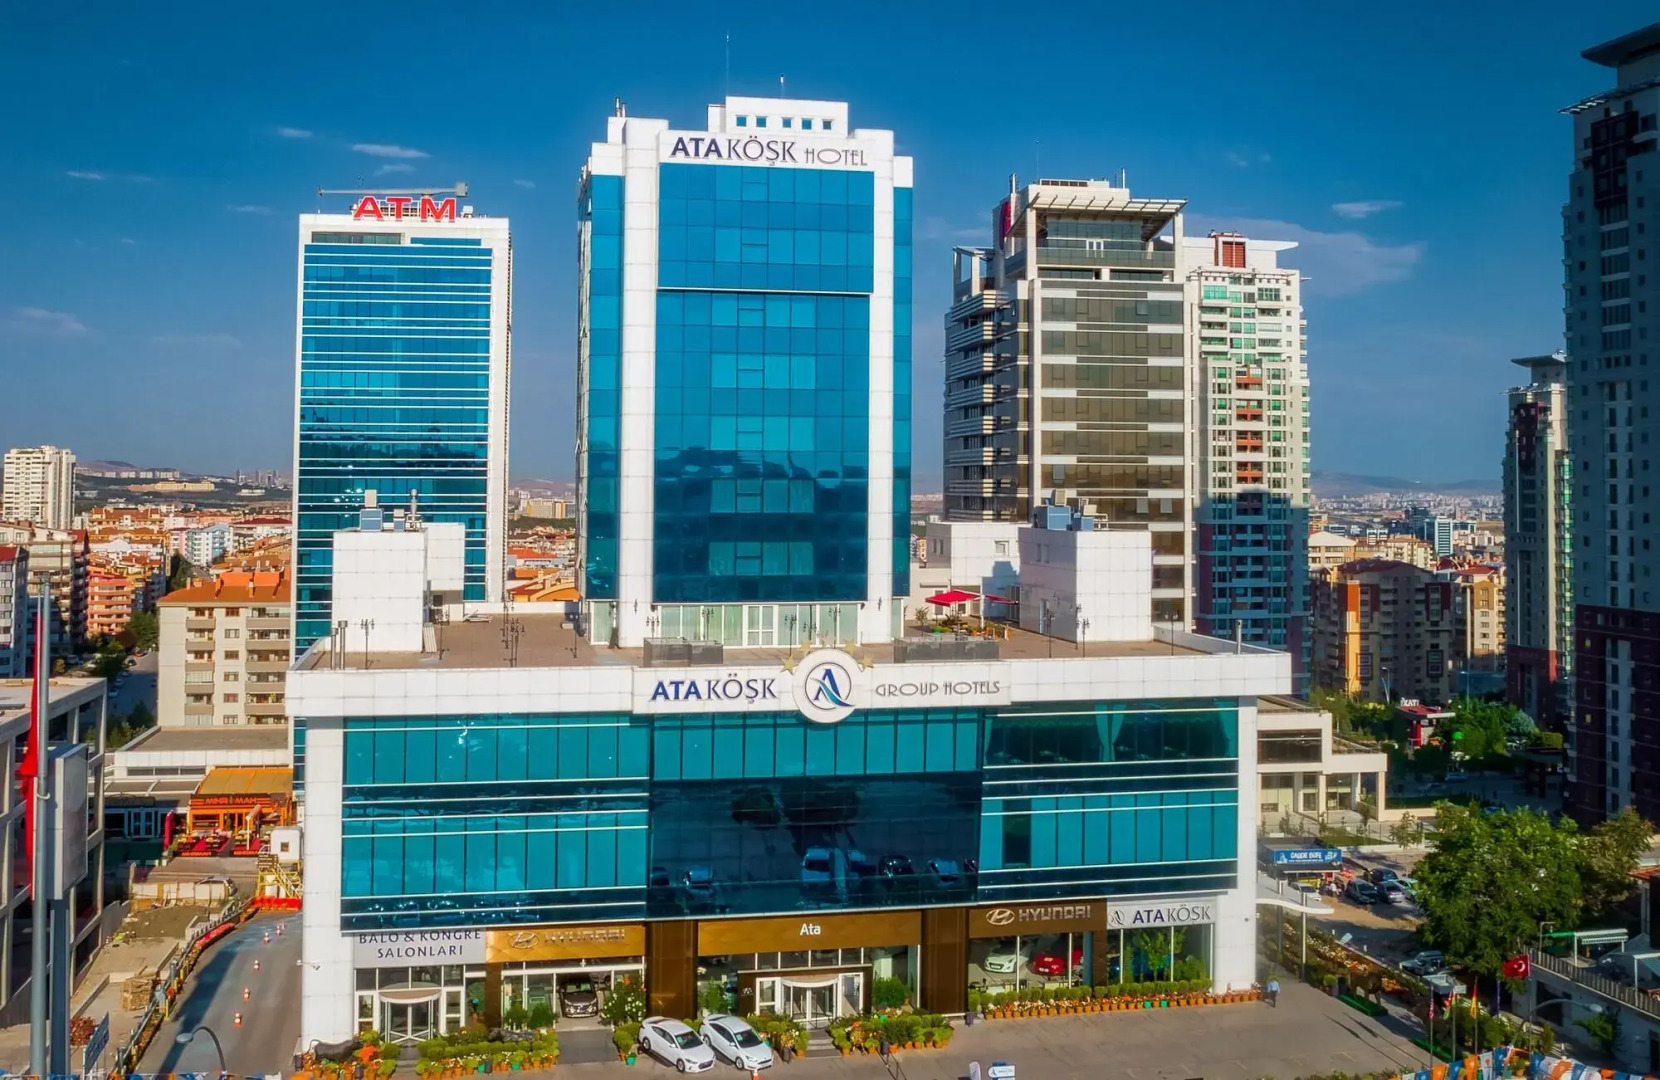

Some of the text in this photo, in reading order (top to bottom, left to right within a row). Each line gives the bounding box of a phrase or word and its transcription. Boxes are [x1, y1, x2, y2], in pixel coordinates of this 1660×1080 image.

[804, 147, 868, 166] HOTEL
[353, 195, 457, 222] ATM
[875, 680, 1000, 697] GROUP HOTELS
[1018, 905, 1092, 922] HYUNDAI
[358, 929, 482, 944] BALO & KONGRE
[799, 923, 821, 936] Ata
[376, 945, 464, 959] SALONLARI
